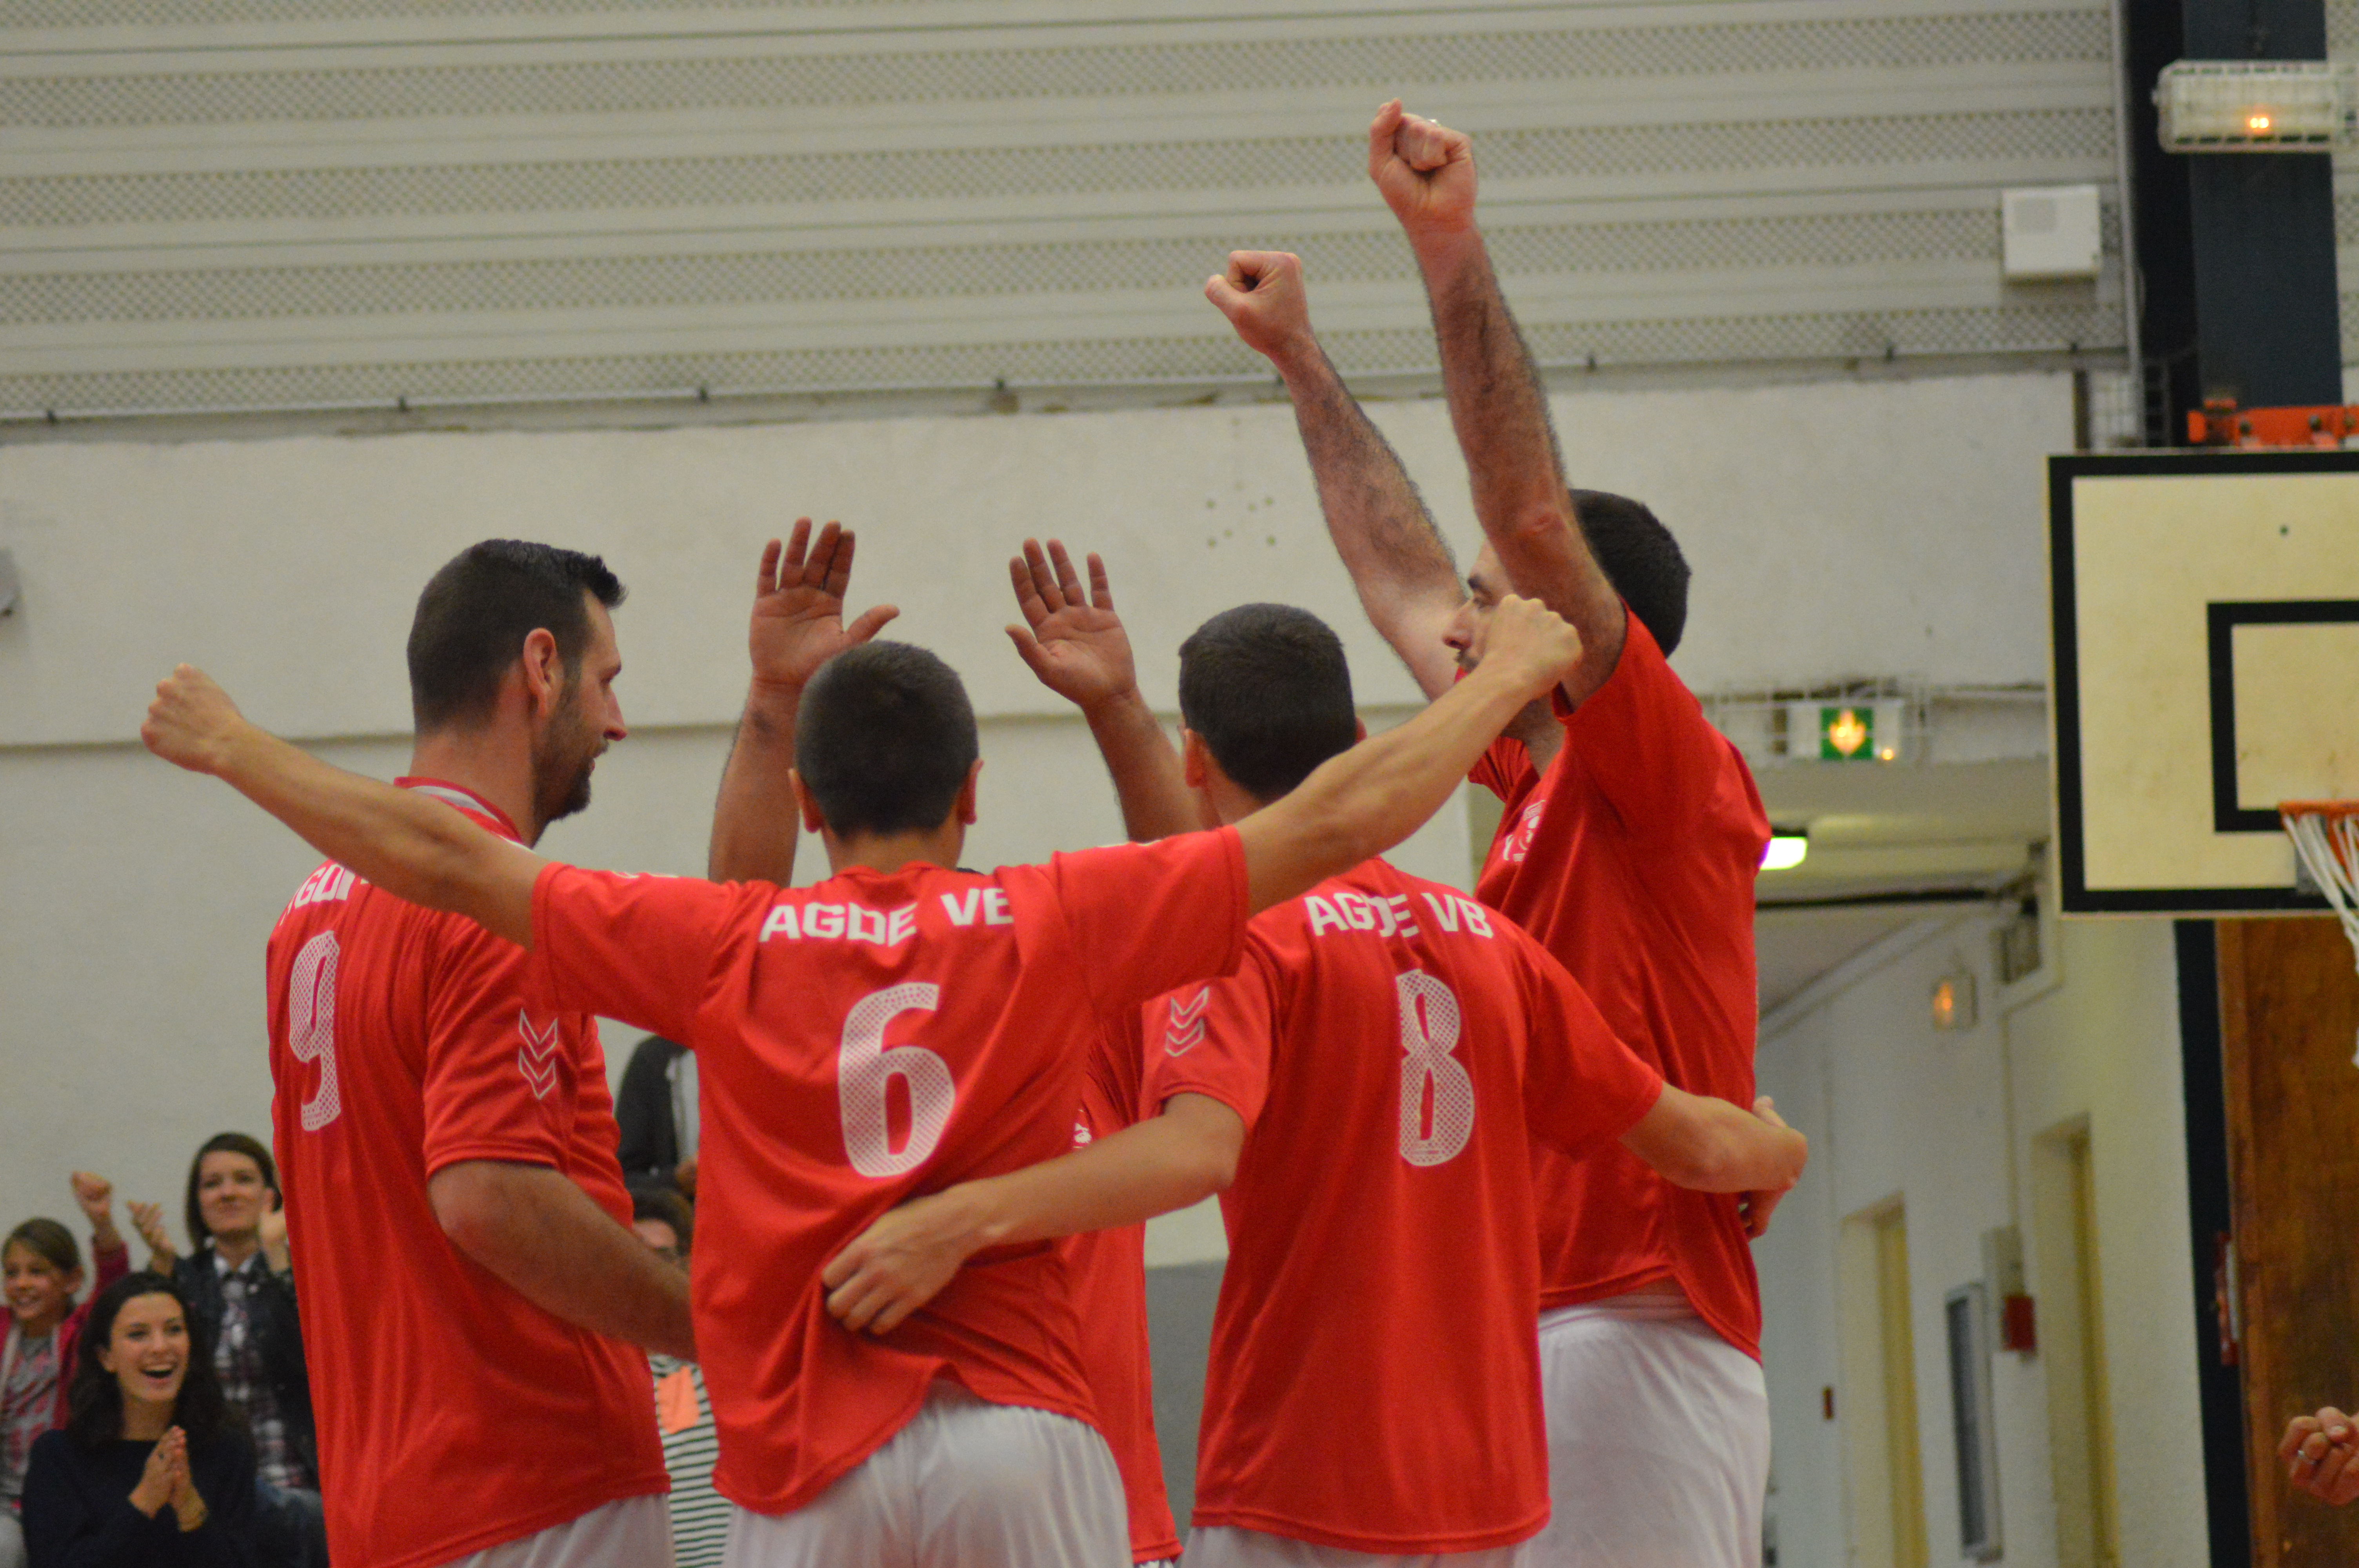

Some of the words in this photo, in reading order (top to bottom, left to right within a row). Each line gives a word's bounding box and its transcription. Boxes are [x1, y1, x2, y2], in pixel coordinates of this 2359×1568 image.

[760, 902, 918, 947] AGDE
[1420, 893, 1494, 938] VB
[289, 930, 341, 1131] 9
[838, 982, 956, 1177] 6
[1396, 969, 1475, 1166] 8
